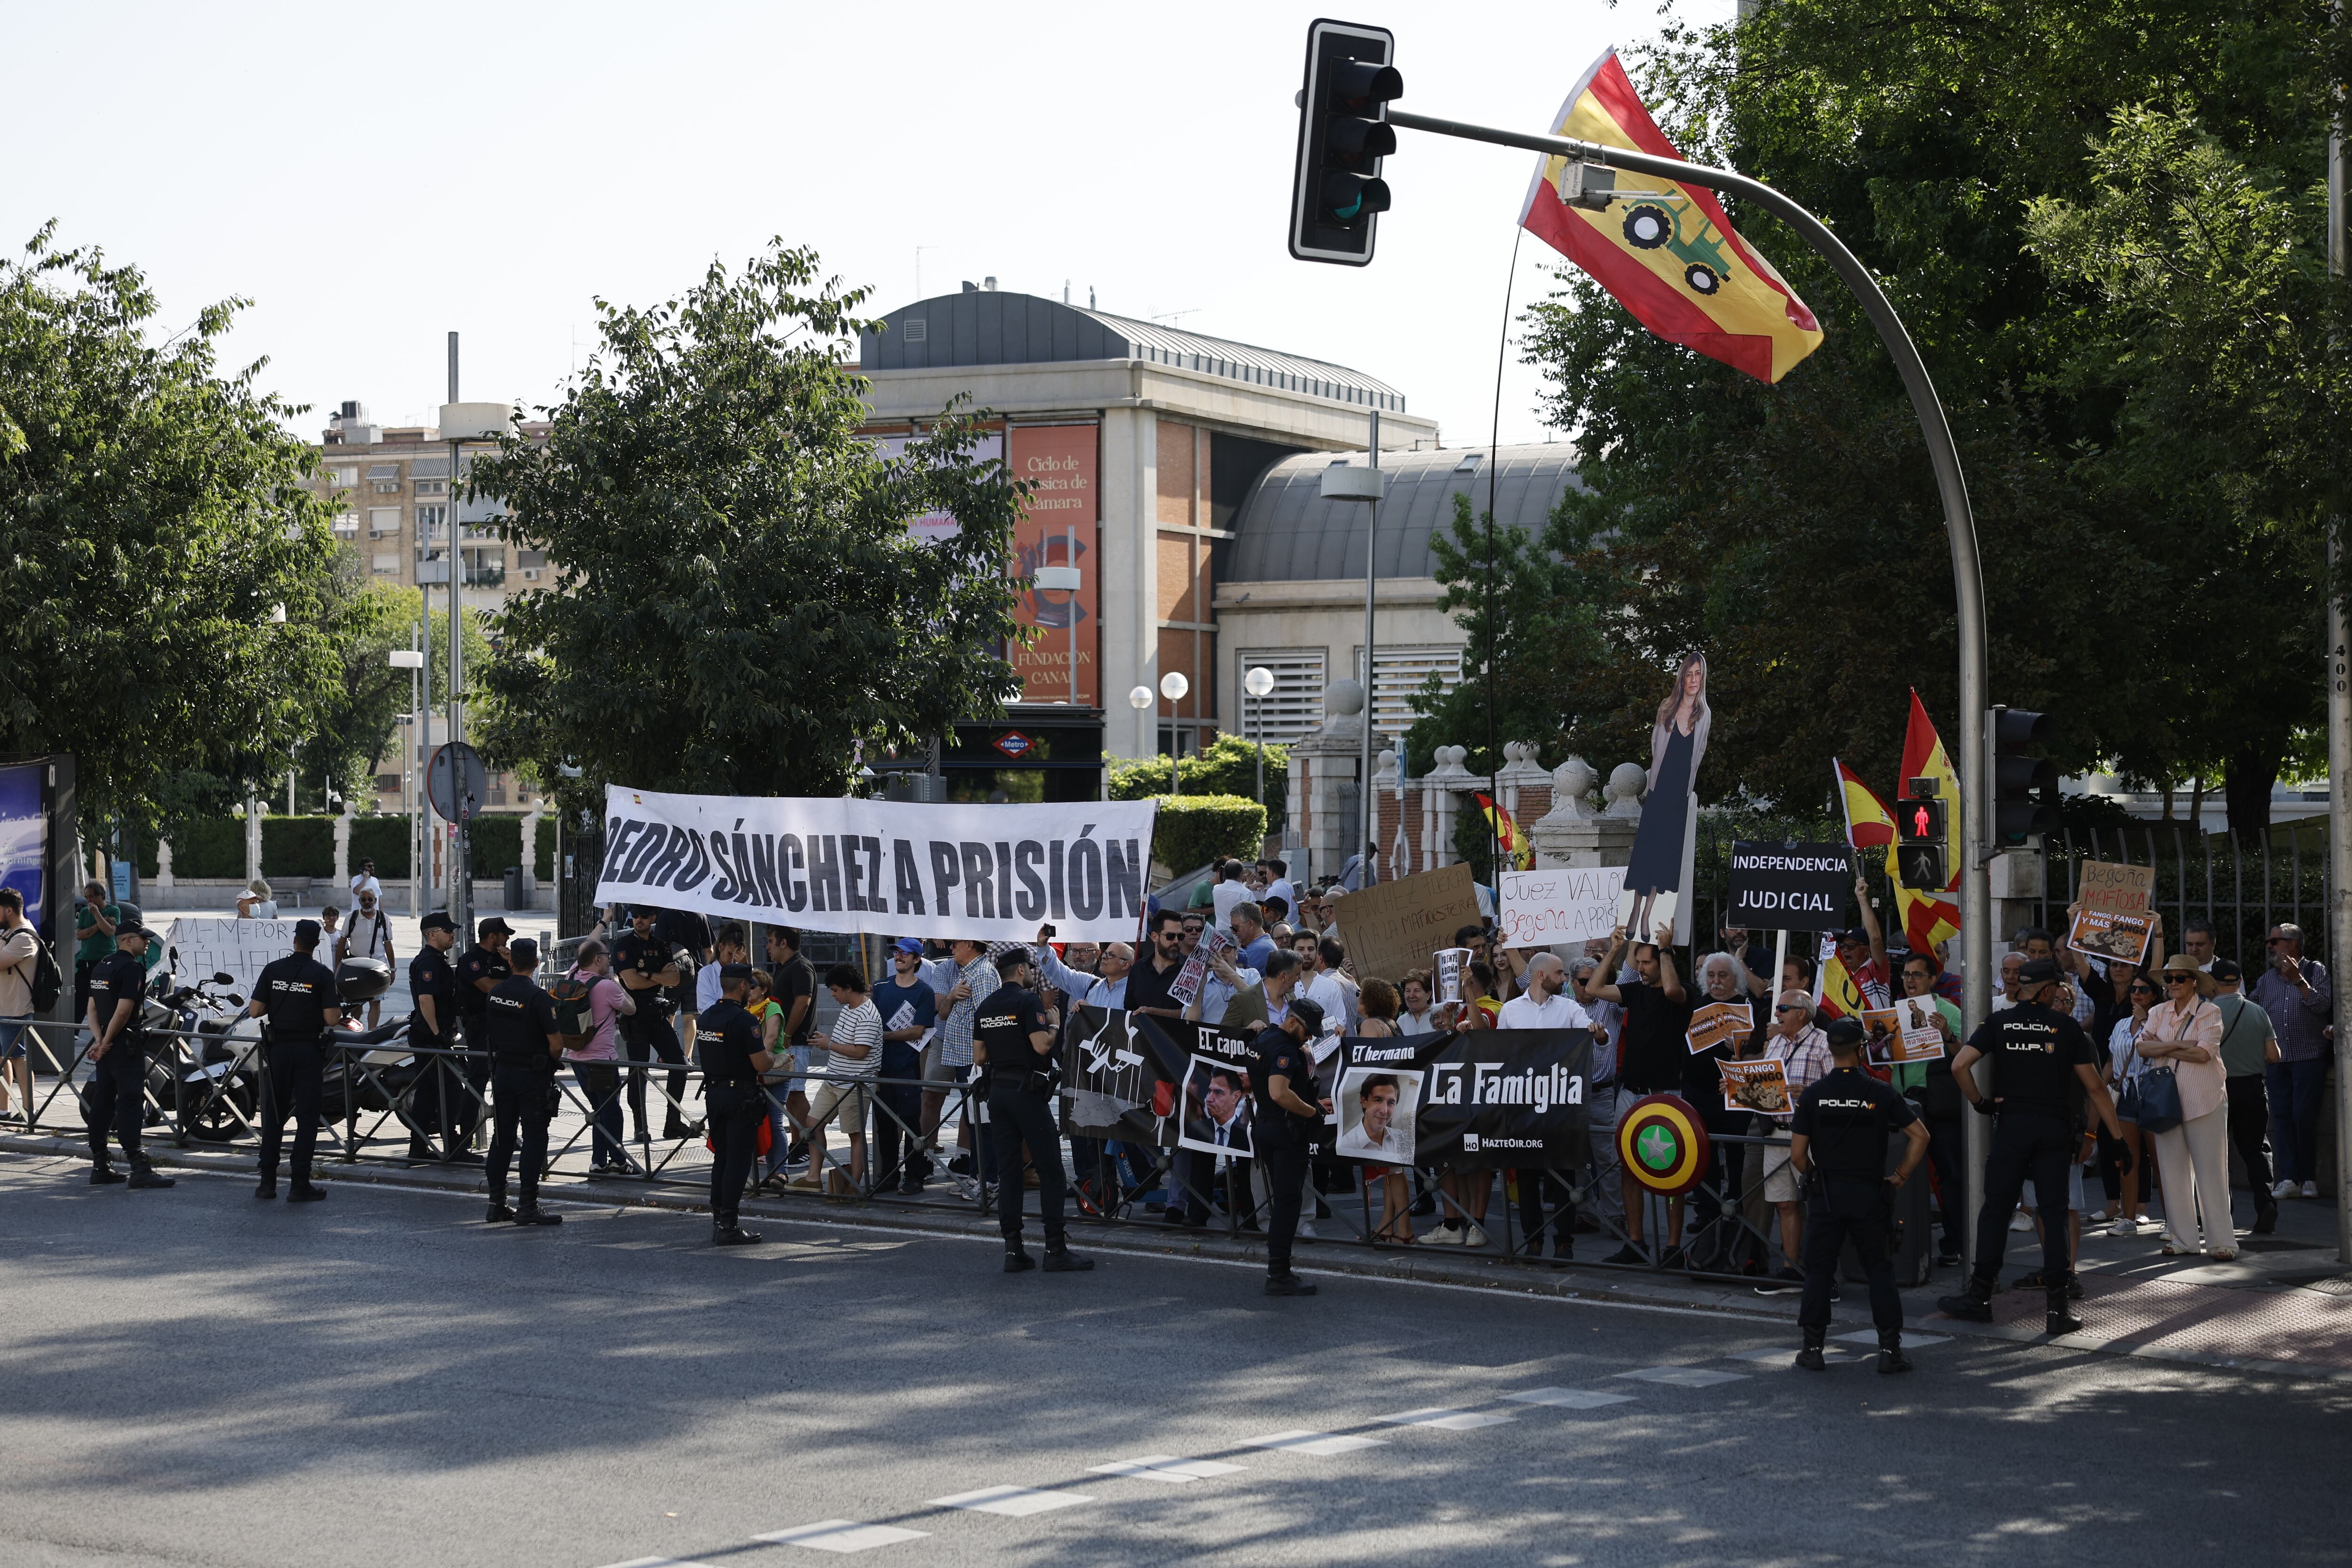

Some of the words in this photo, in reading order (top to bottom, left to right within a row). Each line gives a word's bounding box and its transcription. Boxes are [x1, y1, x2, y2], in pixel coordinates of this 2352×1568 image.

[1027, 456, 1060, 472] Ciclo
[1063, 455, 1079, 470] de
[1070, 474, 1087, 489] de
[920, 518, 956, 527] HUMANA
[1004, 740, 1025, 749] Metro
[710, 818, 889, 913] SÁNCHEZ
[895, 840, 926, 915] A
[929, 824, 1142, 921] PRISIÓN
[1733, 855, 1848, 873] INDEPENDENCIA
[2086, 865, 2145, 888] Begoña
[1500, 875, 1558, 901] Juez
[1738, 890, 1834, 912] JUDICIAL
[1505, 907, 1569, 942] Begoña
[2089, 910, 2113, 921] FANGO,
[2114, 915, 2144, 926] FANGO
[2089, 919, 2110, 928] MÁS
[2111, 922, 2147, 936] FANGO
[272, 985, 312, 993] NACONAL
[490, 995, 519, 1008] POLICIA
[896, 1015, 906, 1025] que
[900, 1010, 911, 1021] esos
[890, 1019, 897, 1027] la
[1690, 1021, 1716, 1034] BEGOÑA
[2003, 1023, 2051, 1032] POLICIA
[1217, 1037, 1246, 1059] capo
[1365, 1046, 1414, 1061] hermano
[2006, 1042, 2043, 1051] U.I.P.
[1723, 1065, 1743, 1074] FANGO,
[1743, 1063, 1775, 1074] FANGO
[1729, 1073, 1746, 1083] MÁS
[1746, 1071, 1783, 1083] FANGO
[1427, 1062, 1465, 1105] La
[1470, 1062, 1583, 1114] Famiglia
[1465, 1142, 1478, 1150] HO
